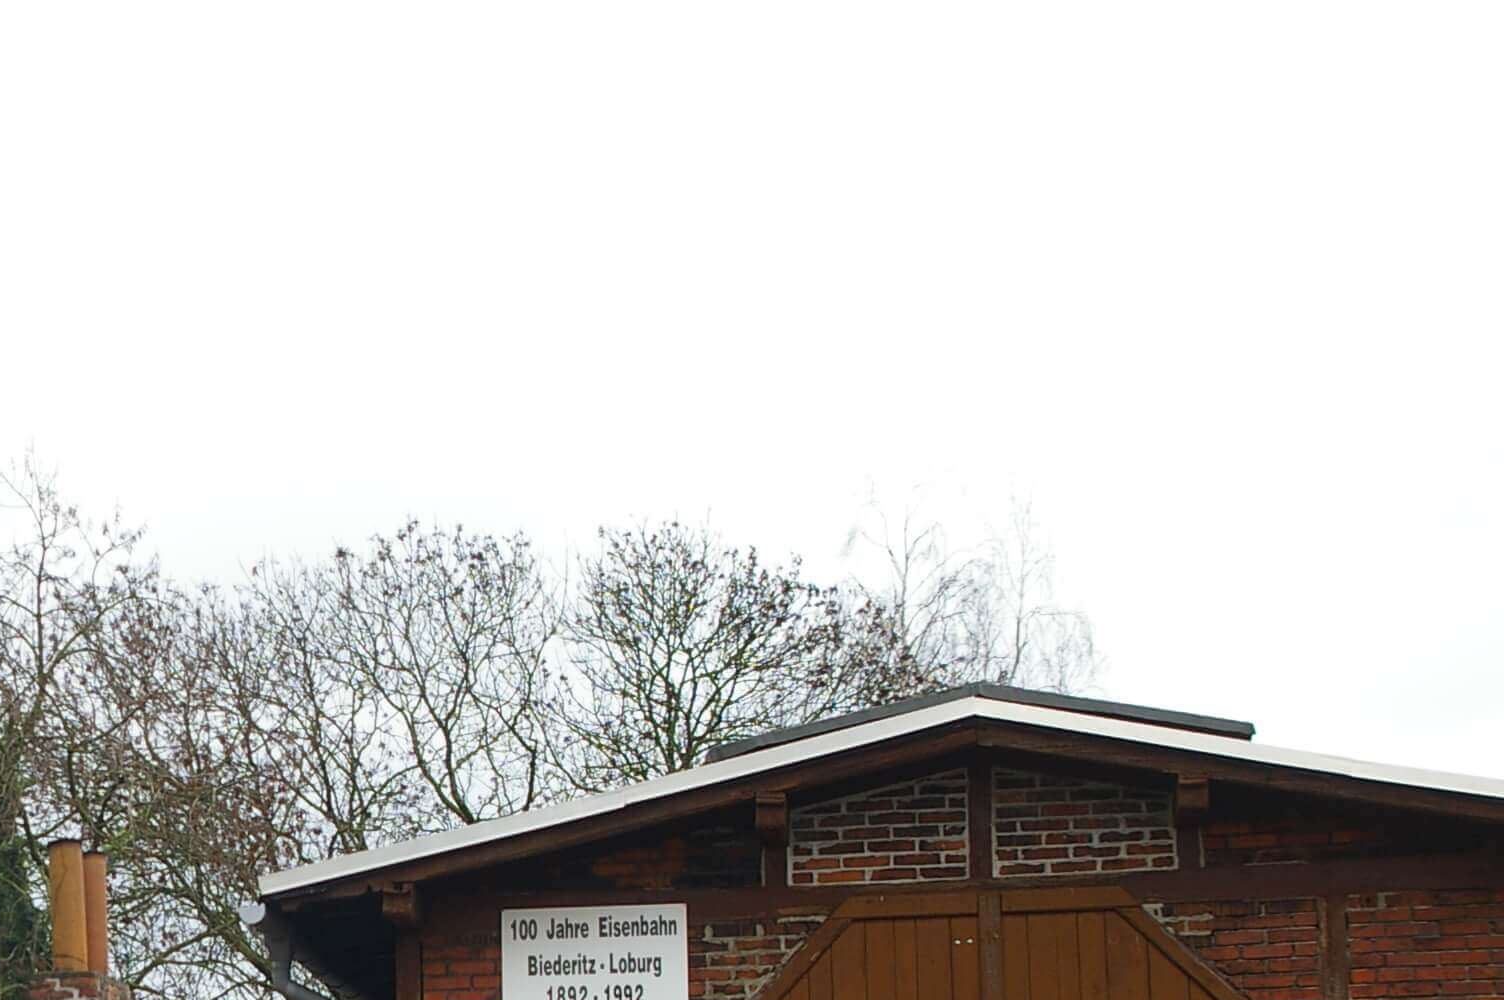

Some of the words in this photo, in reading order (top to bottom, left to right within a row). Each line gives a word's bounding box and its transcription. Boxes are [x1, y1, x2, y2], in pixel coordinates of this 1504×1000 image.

[510, 919, 537, 941] 100
[546, 917, 589, 939] Jahre
[599, 914, 677, 938] Eisenbahn
[527, 953, 596, 976] Biederitz
[609, 952, 662, 977] Loburg
